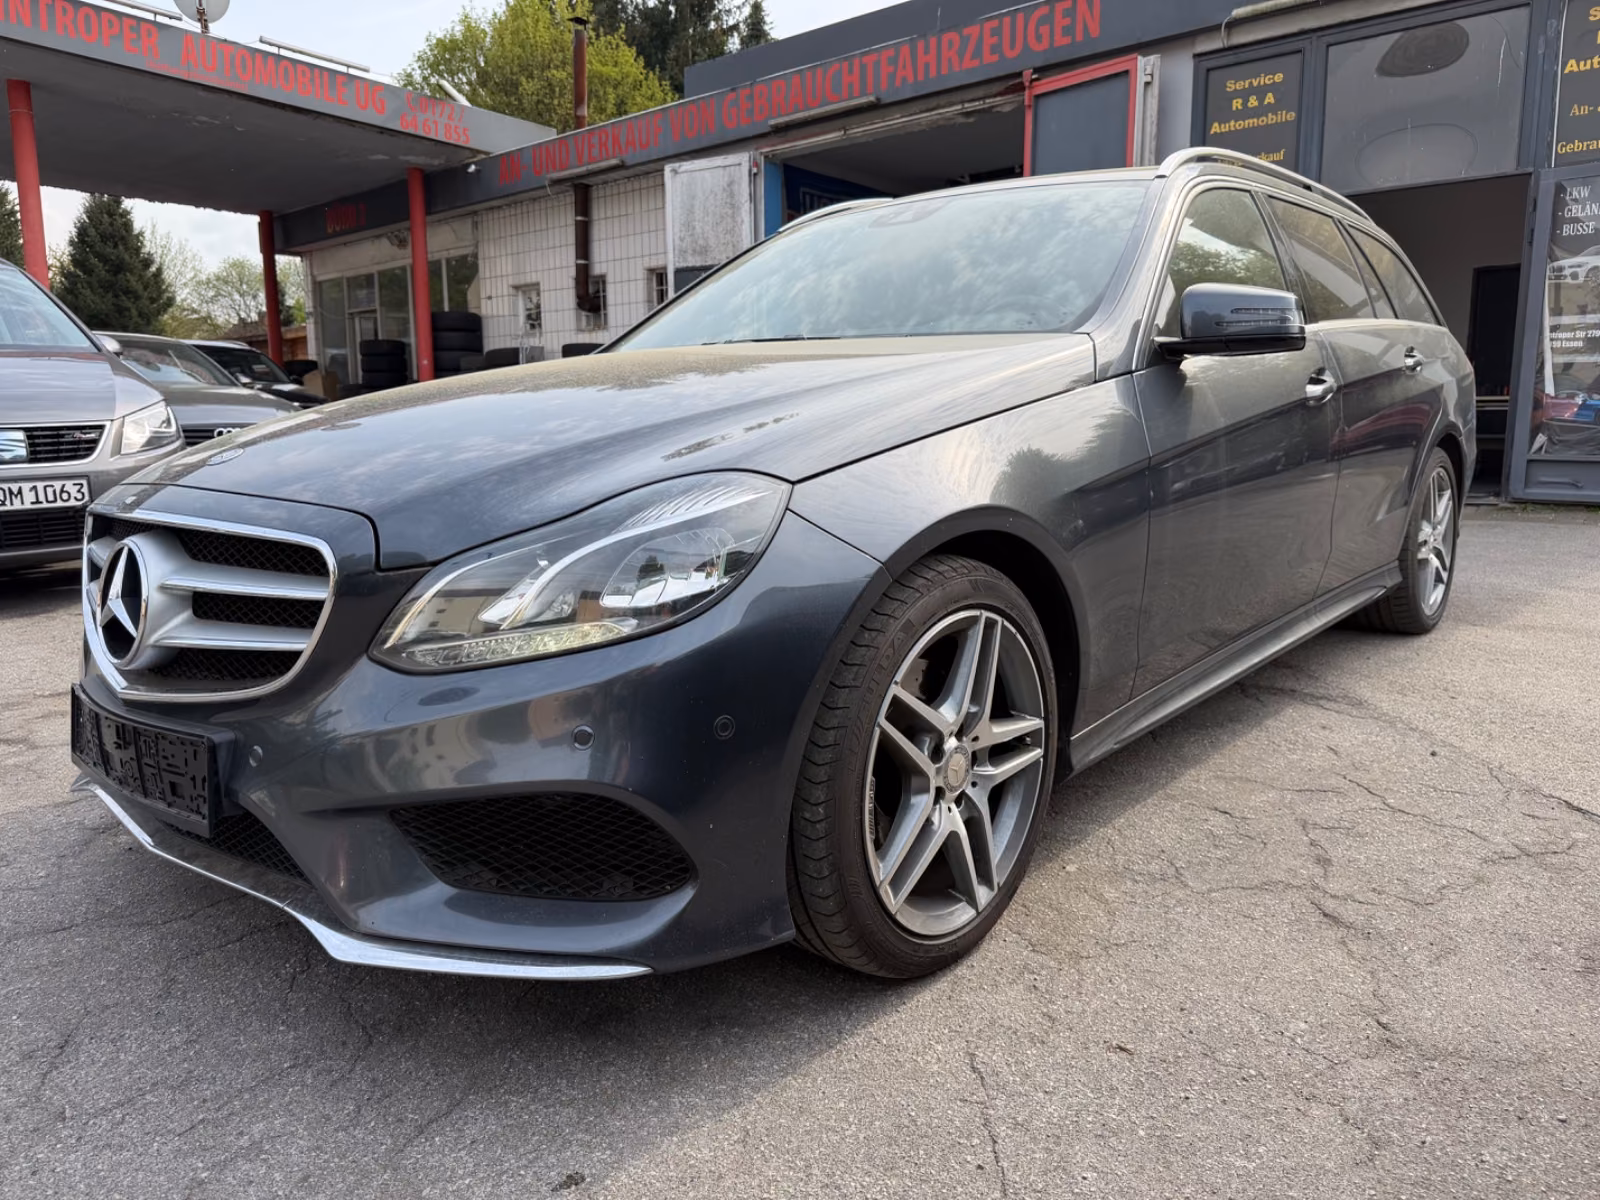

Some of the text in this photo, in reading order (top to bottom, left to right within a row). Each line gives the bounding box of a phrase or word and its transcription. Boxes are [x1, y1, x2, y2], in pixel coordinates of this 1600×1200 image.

[181, 33, 348, 107] AUTOMOBILE
[355, 79, 387, 115] UG
[1226, 72, 1284, 92] Service
[531, 139, 570, 176] UND
[574, 112, 665, 166] VERKAUF
[670, 101, 716, 142] VON
[722, 0, 1100, 129] GEBRAUCHTFAHRZEUGEN
[419, 96, 455, 122] 0172
[1232, 92, 1275, 111] R & A
[400, 112, 471, 145] 64 61 855
[1210, 109, 1296, 135] Automobile
[1566, 185, 1591, 200] LKW
[1564, 200, 1600, 218] GELÄN
[1562, 221, 1595, 236] BUSSE
[29, 482, 86, 505] 1063
